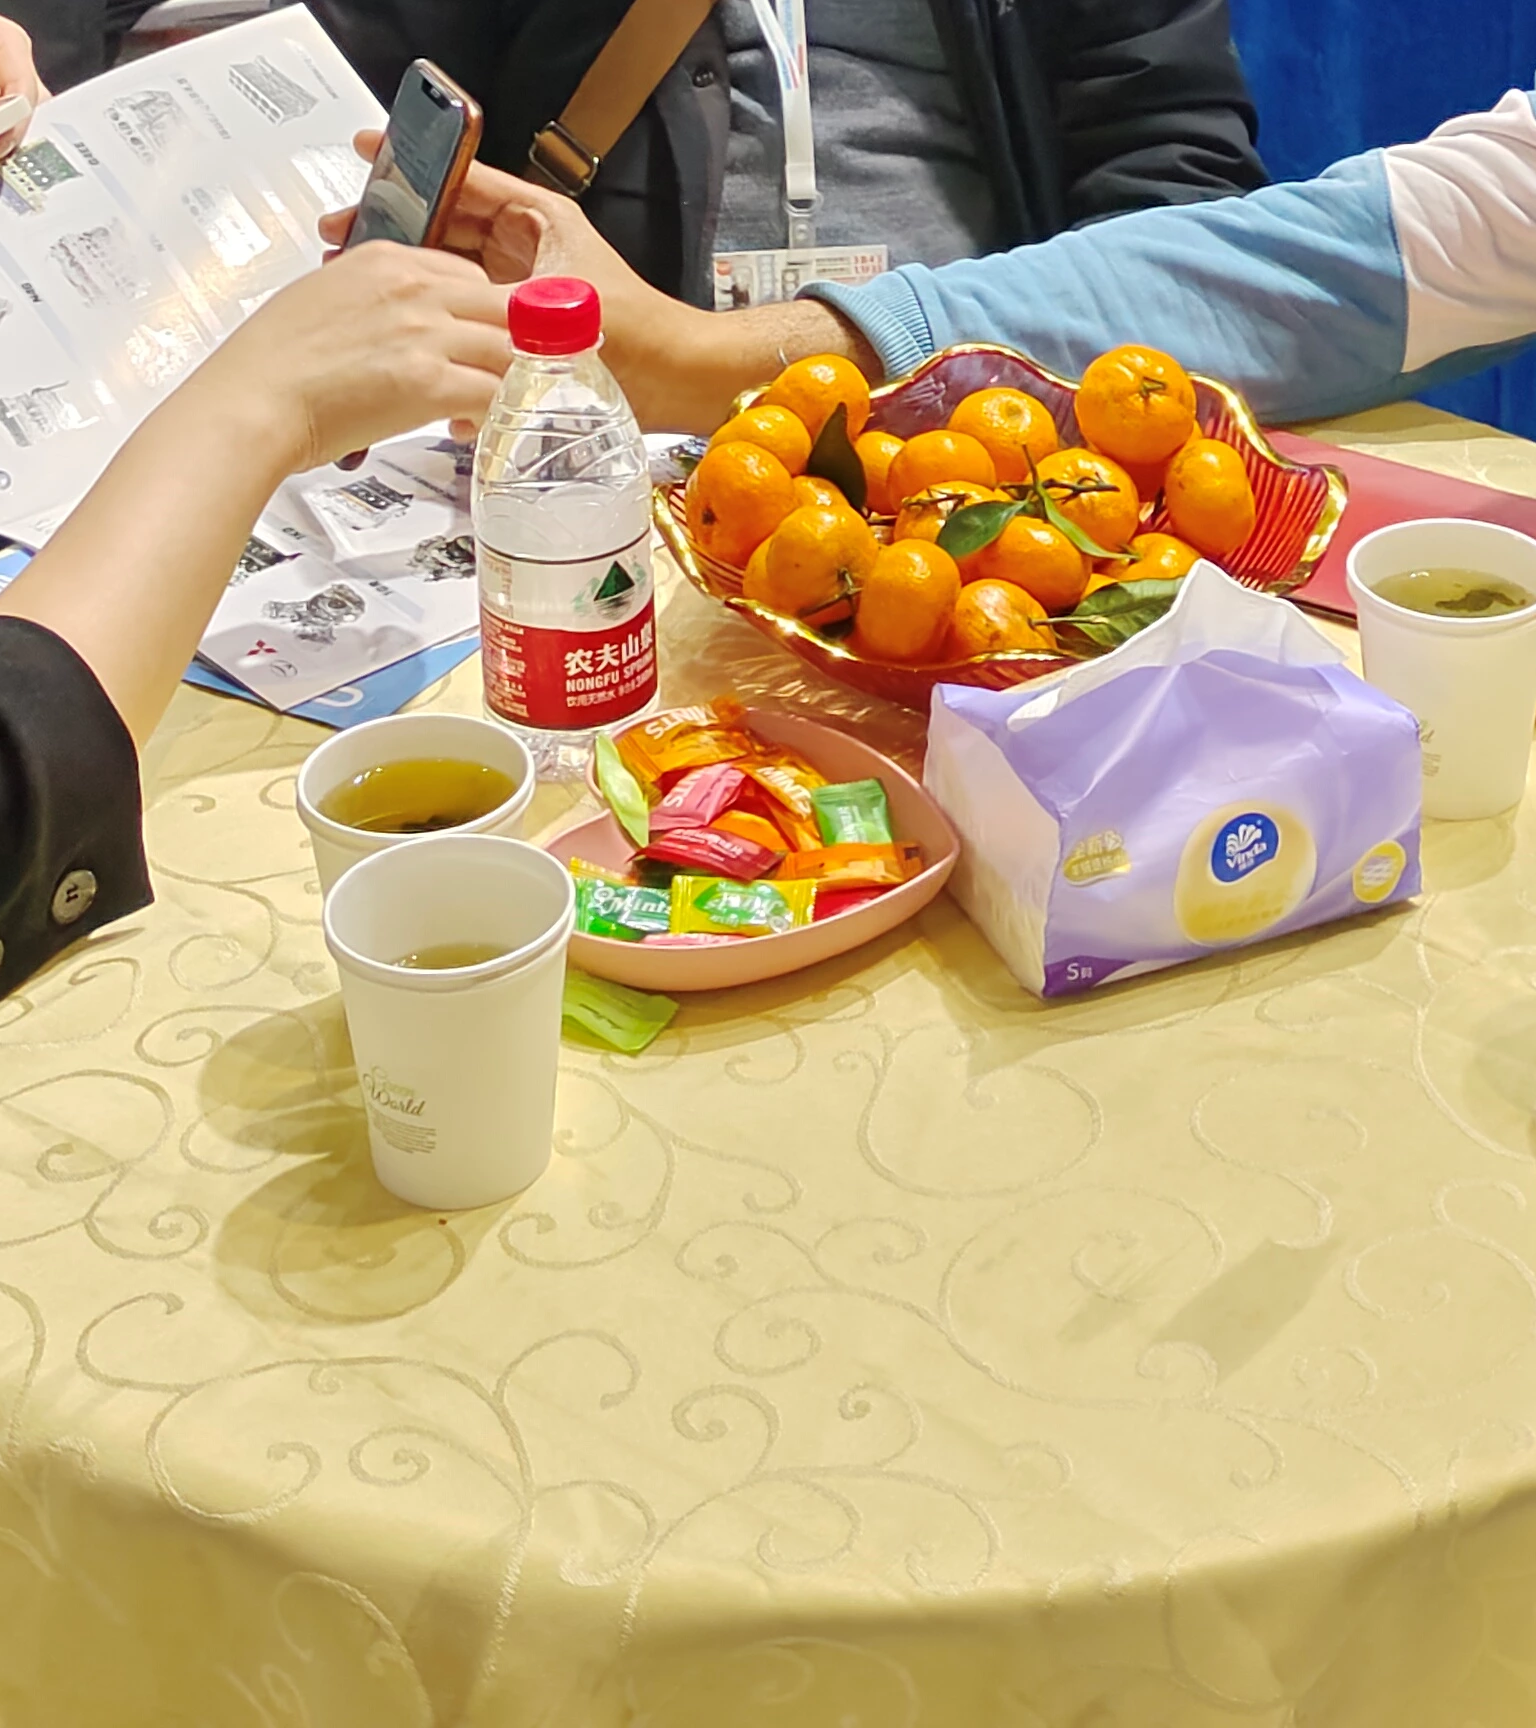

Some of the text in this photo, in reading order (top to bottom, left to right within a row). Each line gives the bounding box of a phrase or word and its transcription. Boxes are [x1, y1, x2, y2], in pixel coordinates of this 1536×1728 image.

[565, 619, 654, 677] 农夫山泉
[566, 669, 621, 694] NONGFU
[644, 703, 718, 740] MINTS
[755, 766, 812, 822] MINTS
[1226, 842, 1267, 869] Vinda
[363, 1073, 426, 1117] World
